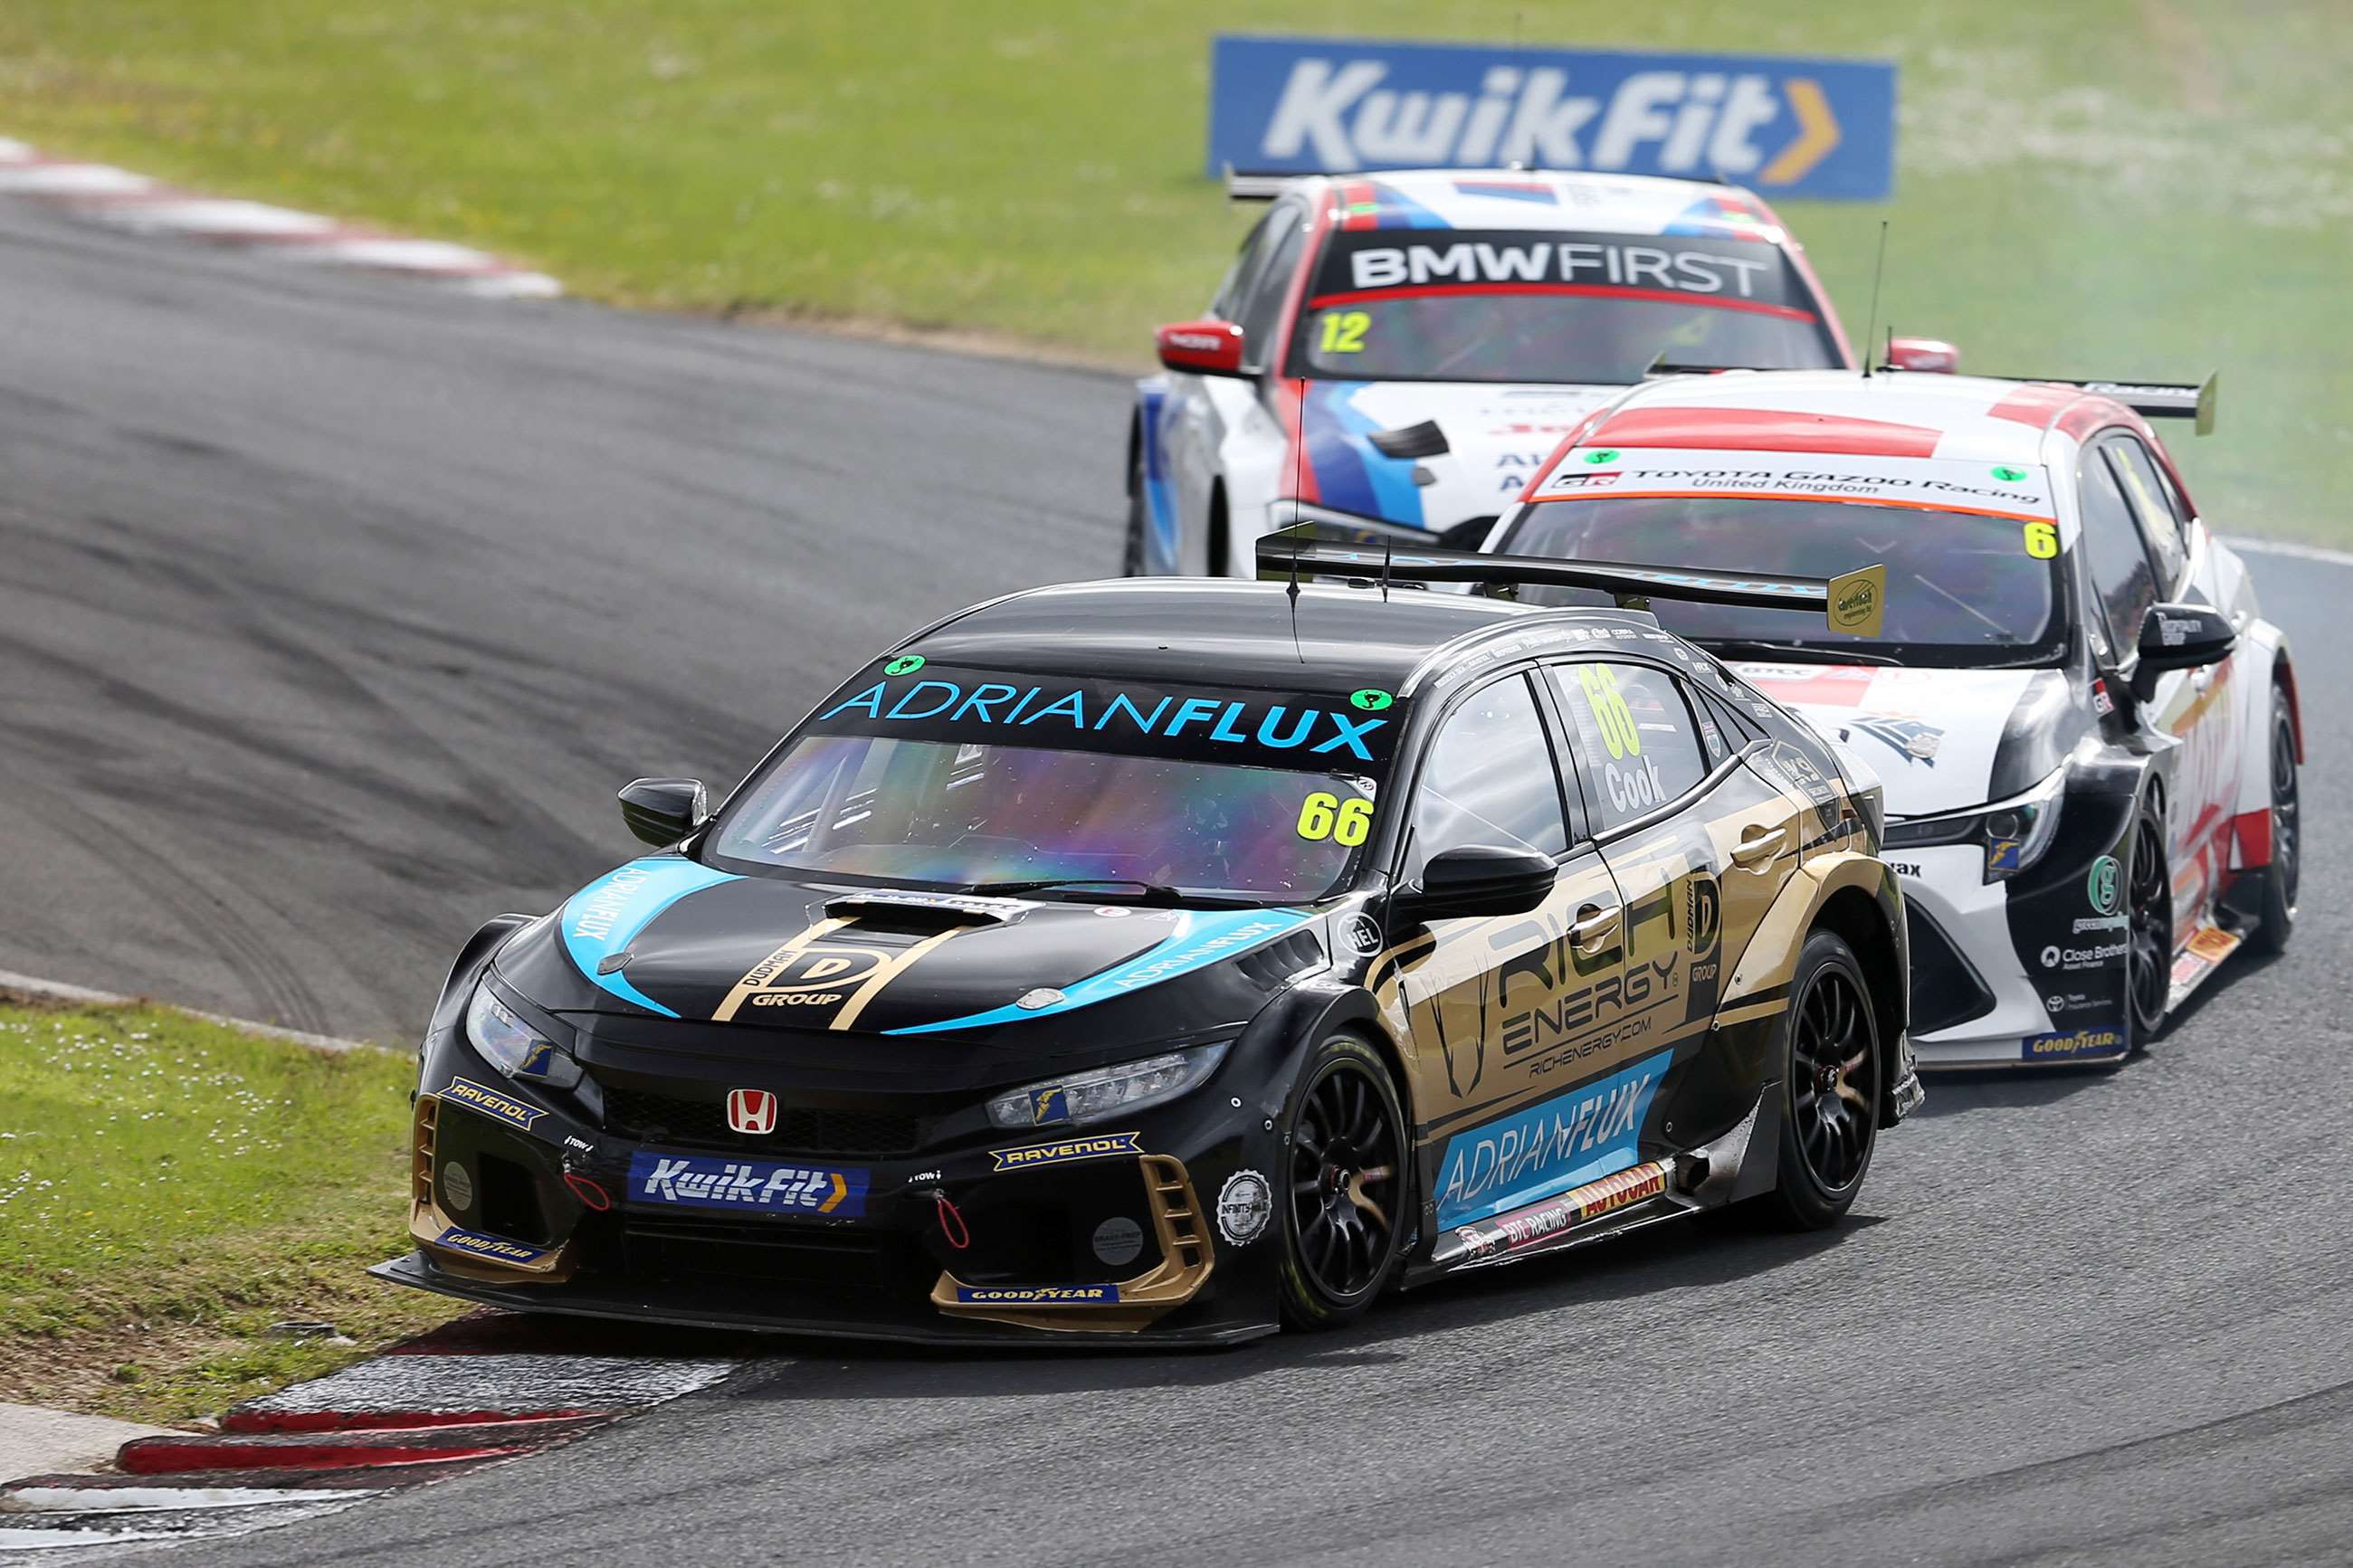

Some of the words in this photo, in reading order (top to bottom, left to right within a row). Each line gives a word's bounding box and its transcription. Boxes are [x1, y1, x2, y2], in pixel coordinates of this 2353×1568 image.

[1319, 312, 1371, 353] 12
[1632, 470, 1771, 479] TOYOTA
[1921, 480, 2041, 504] Racing
[1692, 479, 1767, 489] United
[1774, 480, 1879, 494] Kingdom
[2023, 521, 2057, 560] 6
[1578, 663, 1641, 760] 66
[1605, 755, 1667, 813] Cook
[1296, 792, 1374, 847] 66
[1346, 927, 1379, 950] HEL
[1487, 867, 1676, 1009] RICH
[2062, 948, 2093, 962] Close
[742, 950, 797, 986] DUDMAN
[1692, 964, 1718, 982] GROUP
[752, 993, 843, 1007] GROUP
[1502, 951, 1679, 1055] ENERGY
[2032, 1031, 2115, 1053] GOODYEAR
[451, 1084, 527, 1122] RAVENOL
[1006, 1140, 1127, 1164] RAVENOL
[1505, 1221, 1530, 1243] BTC
[1530, 1208, 1567, 1238] RACING
[447, 1233, 533, 1259] GOODYEAR
[971, 1287, 1104, 1301] GOODYEAR
